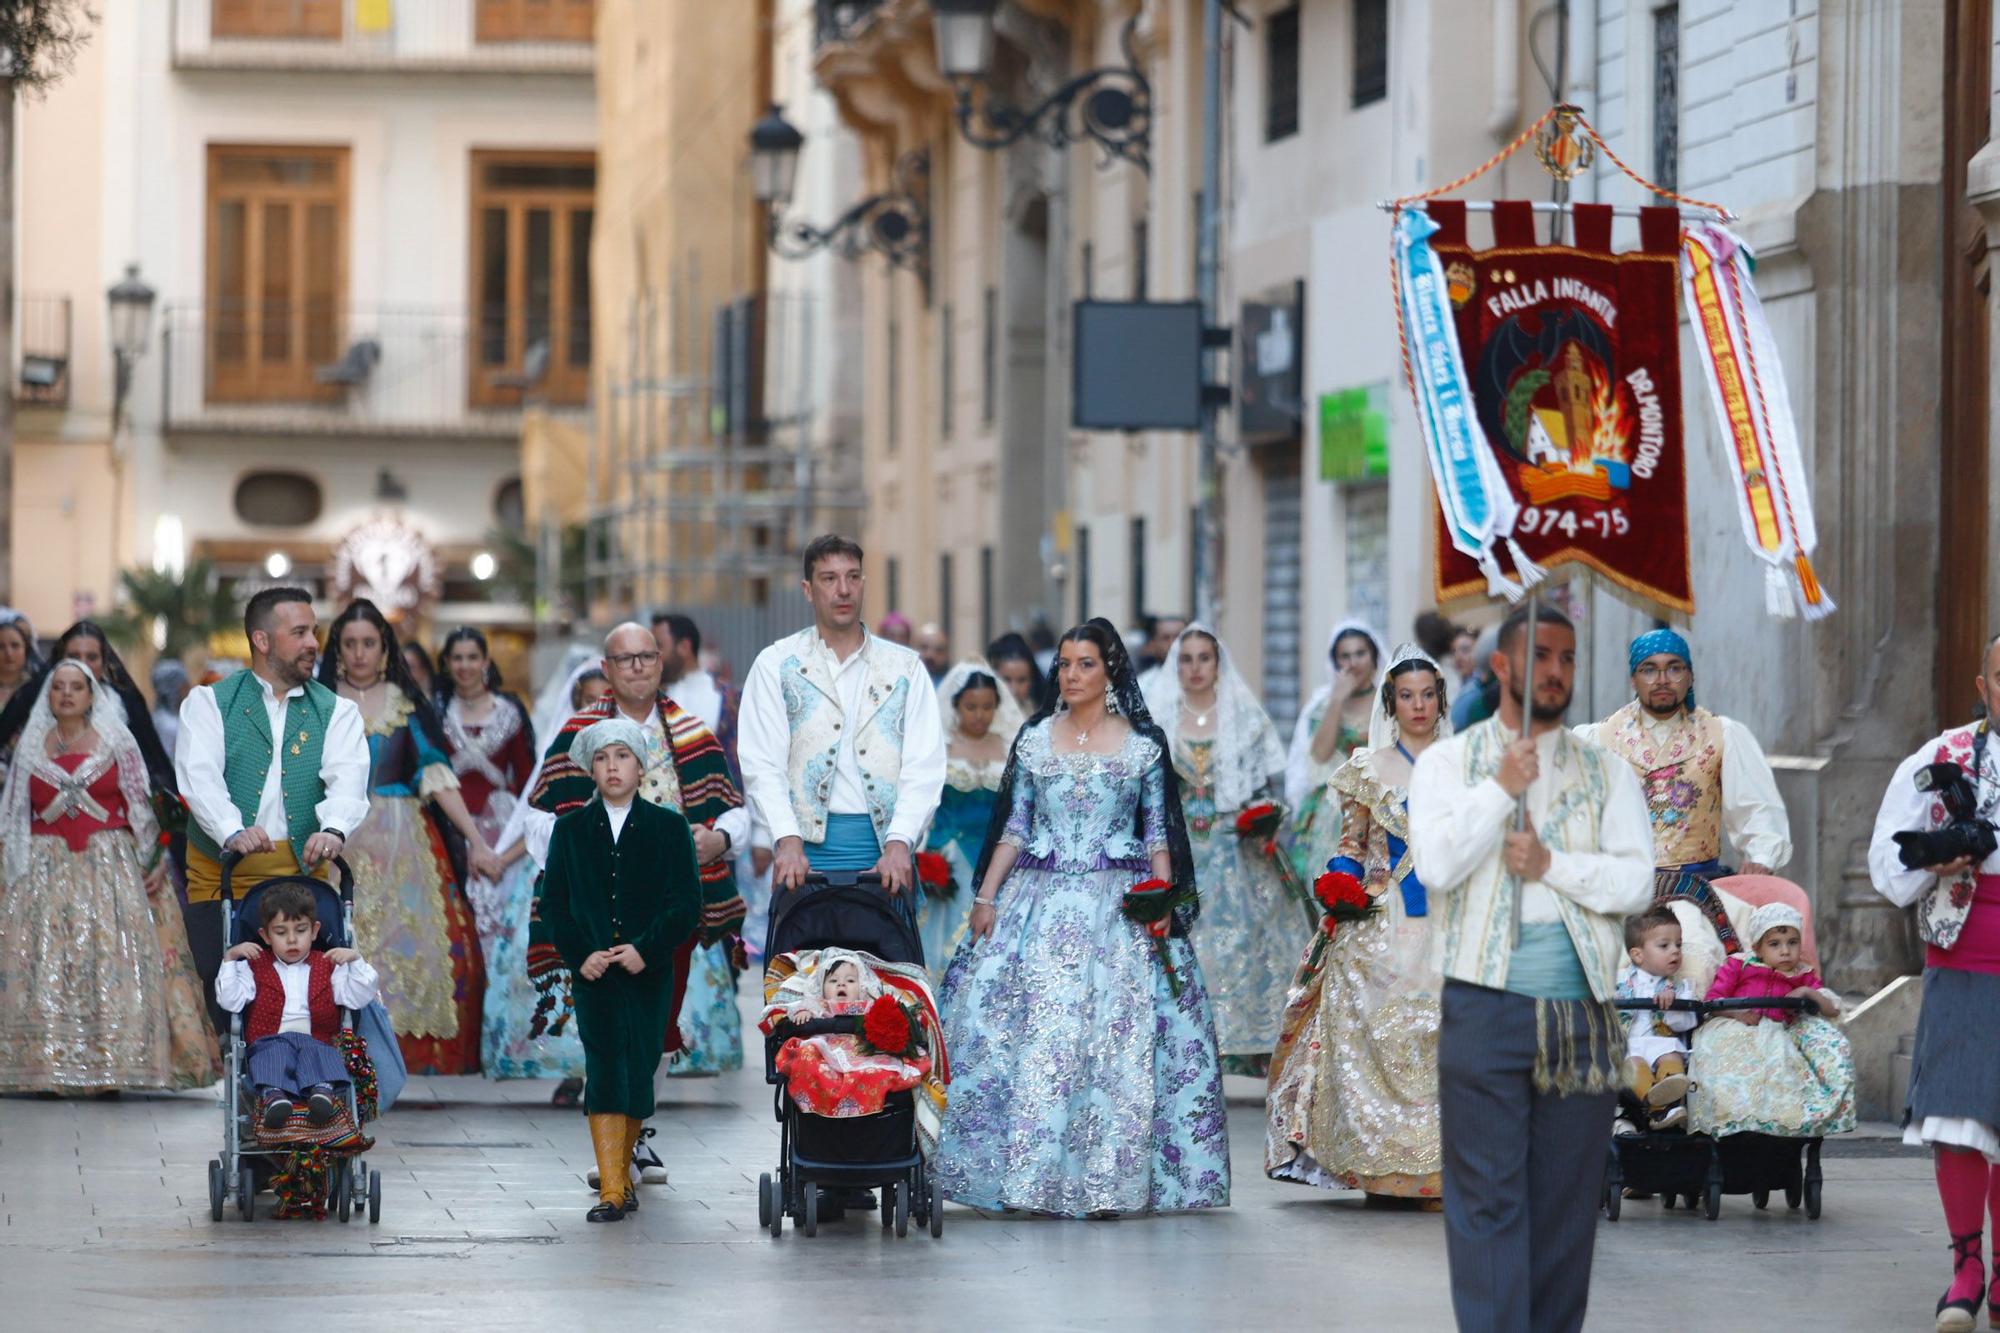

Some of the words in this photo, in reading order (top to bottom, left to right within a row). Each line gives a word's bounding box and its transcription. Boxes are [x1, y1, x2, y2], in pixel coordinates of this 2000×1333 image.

[1487, 279, 1549, 318] FALLA
[1553, 276, 1617, 328] INFANTIL
[1515, 503, 1630, 539] 974-75
